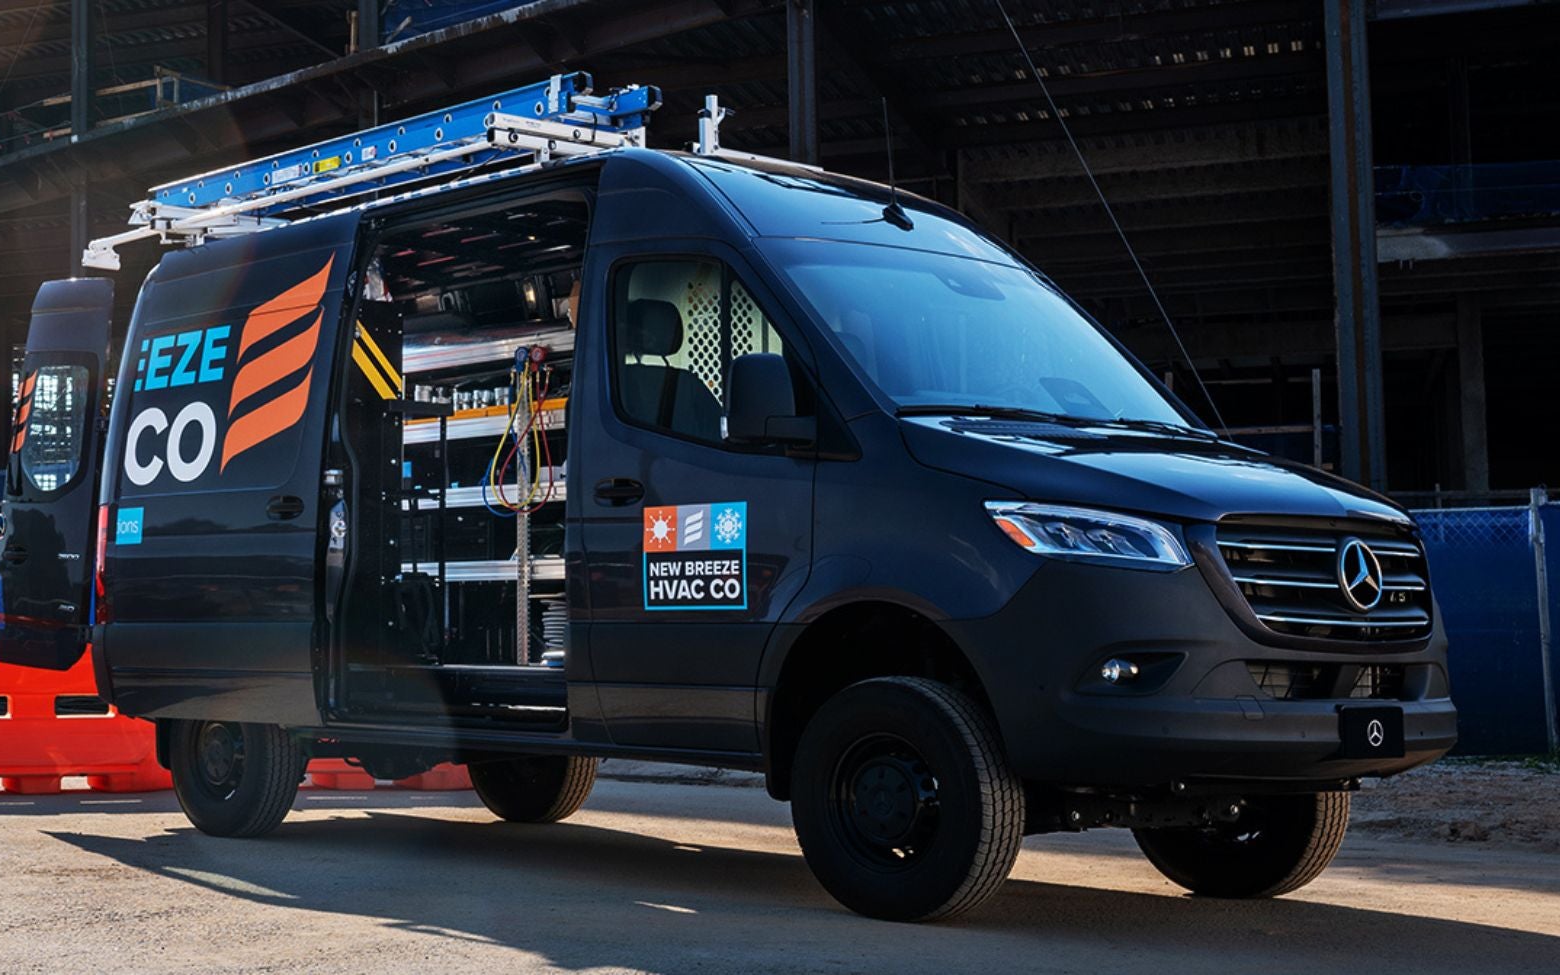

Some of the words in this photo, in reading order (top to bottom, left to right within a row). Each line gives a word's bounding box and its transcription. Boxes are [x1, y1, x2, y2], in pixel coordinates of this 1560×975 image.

[124, 401, 217, 486] CO
[649, 562, 682, 577] NEW
[685, 560, 740, 576] BREEZE
[649, 579, 705, 600] HVAC
[709, 578, 741, 599] CO
